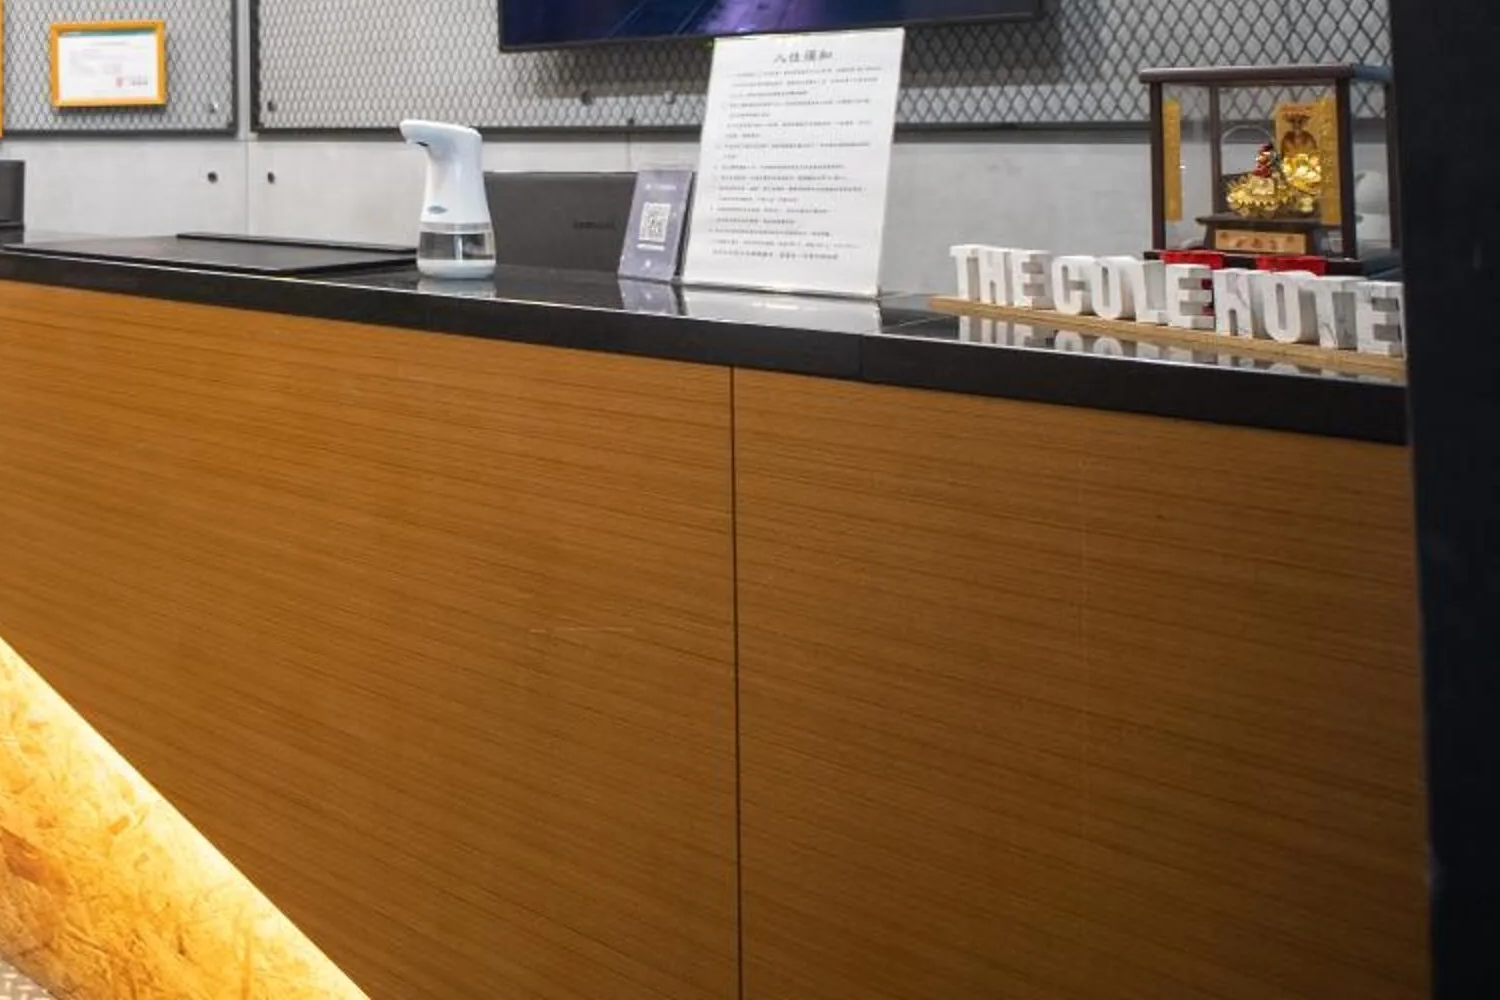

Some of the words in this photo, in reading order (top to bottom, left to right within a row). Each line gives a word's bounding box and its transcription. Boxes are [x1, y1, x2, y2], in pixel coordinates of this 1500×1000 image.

[949, 244, 1052, 310] THE
[1052, 254, 1216, 330] COLE
[1213, 267, 1406, 358] HOTE
